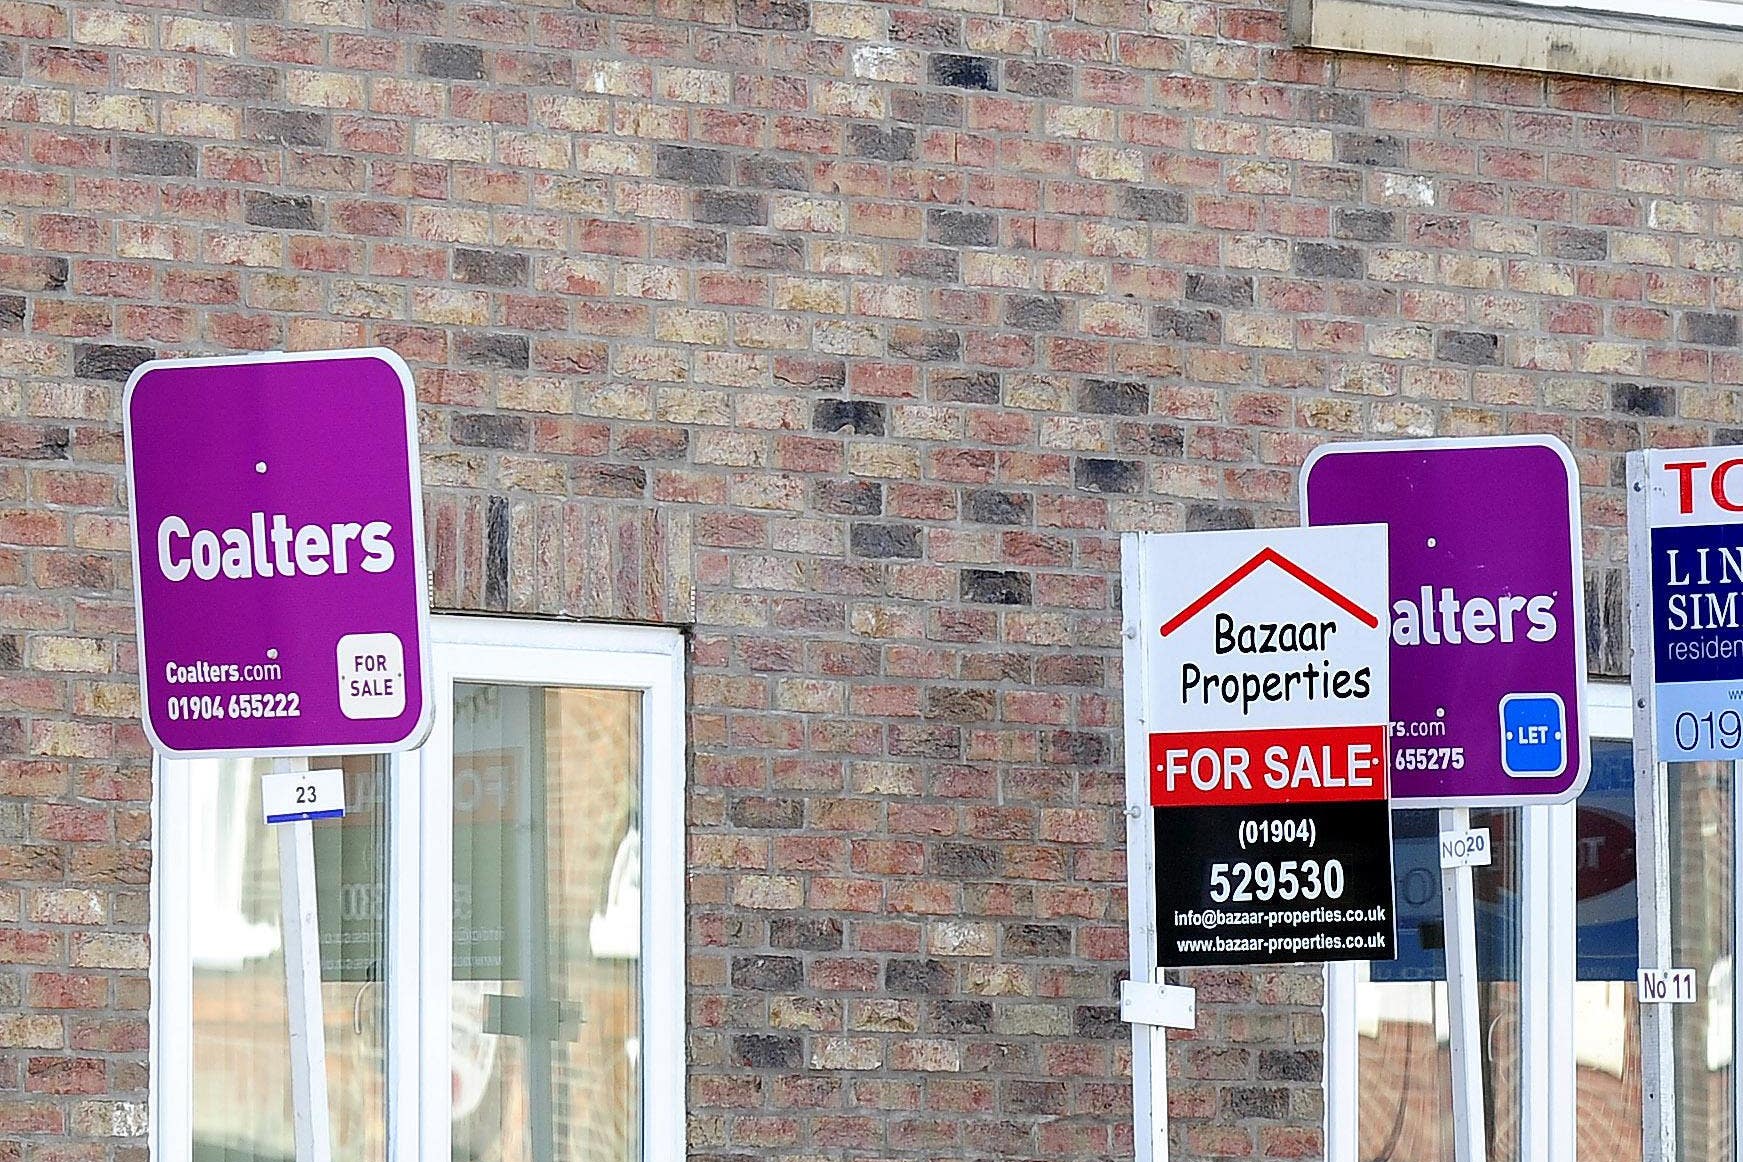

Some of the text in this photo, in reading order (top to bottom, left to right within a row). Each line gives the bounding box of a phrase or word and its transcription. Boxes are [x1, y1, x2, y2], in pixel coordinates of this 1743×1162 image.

[157, 511, 396, 583] Coalters
[1391, 585, 1559, 647] alters
[1214, 612, 1338, 655] Bazaar
[165, 659, 282, 685] Coalters.com
[354, 653, 388, 673] FOR
[350, 677, 394, 698] SALE
[1182, 660, 1372, 713] Properties
[167, 692, 301, 722] 01904 655222
[1517, 725, 1550, 746] LET
[1163, 743, 1374, 792] FOR SALE
[1395, 747, 1465, 771] 655275
[295, 785, 318, 805] 23
[1238, 818, 1316, 850] (01904)
[1209, 858, 1345, 903] 529530
[1174, 905, 1386, 930] info@bazaar-properties.co.uk
[1176, 931, 1386, 954] www.bazaar-properties.co.uk
[1672, 973, 1691, 999] 11
